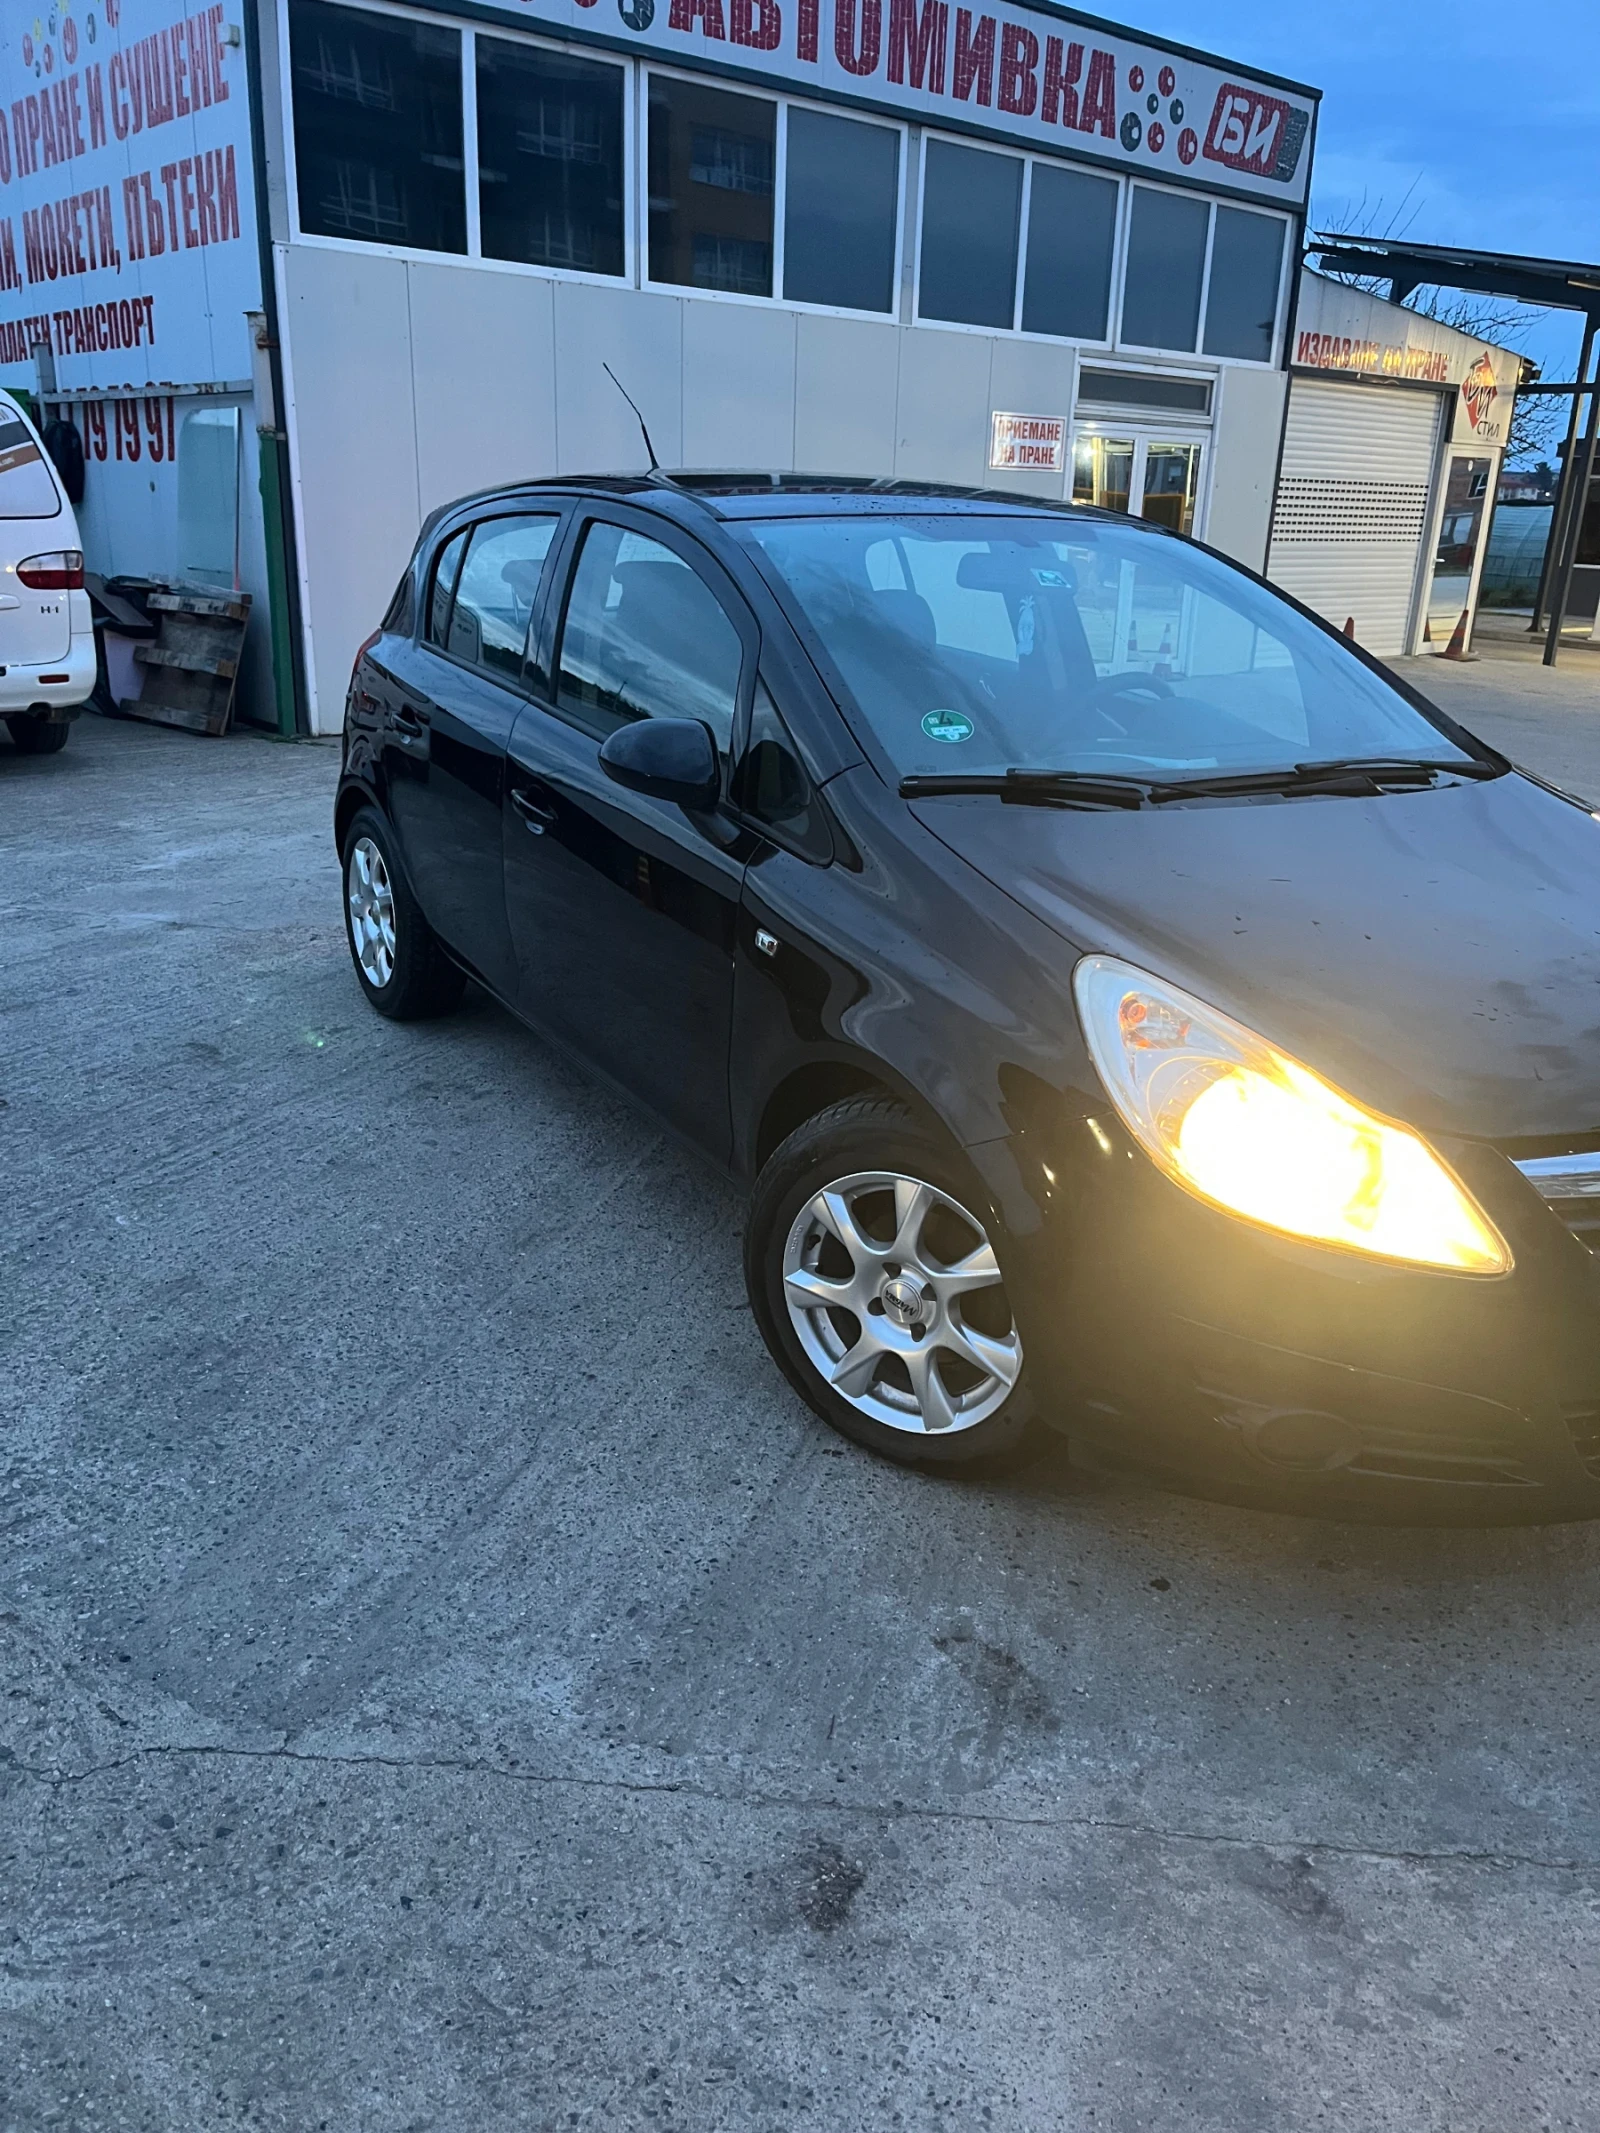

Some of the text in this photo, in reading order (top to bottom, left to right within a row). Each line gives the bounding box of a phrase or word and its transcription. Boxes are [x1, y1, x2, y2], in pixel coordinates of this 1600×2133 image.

[11, 72, 86, 179] ПРАНЕ
[85, 62, 107, 150] И
[109, 3, 229, 141] СУШЕНЕ
[22, 185, 120, 284] МОКЕТИ,
[122, 144, 240, 262] ПЪТЕКИ
[53, 295, 155, 356] ТРАНСПОРТ
[1297, 331, 1380, 373] ИЗДАВАНЕ
[998, 419, 1061, 441] ПРИЕМАНЕ
[1477, 421, 1500, 438] СТИЛ
[1000, 444, 1055, 465] НА ПРАНЕ
